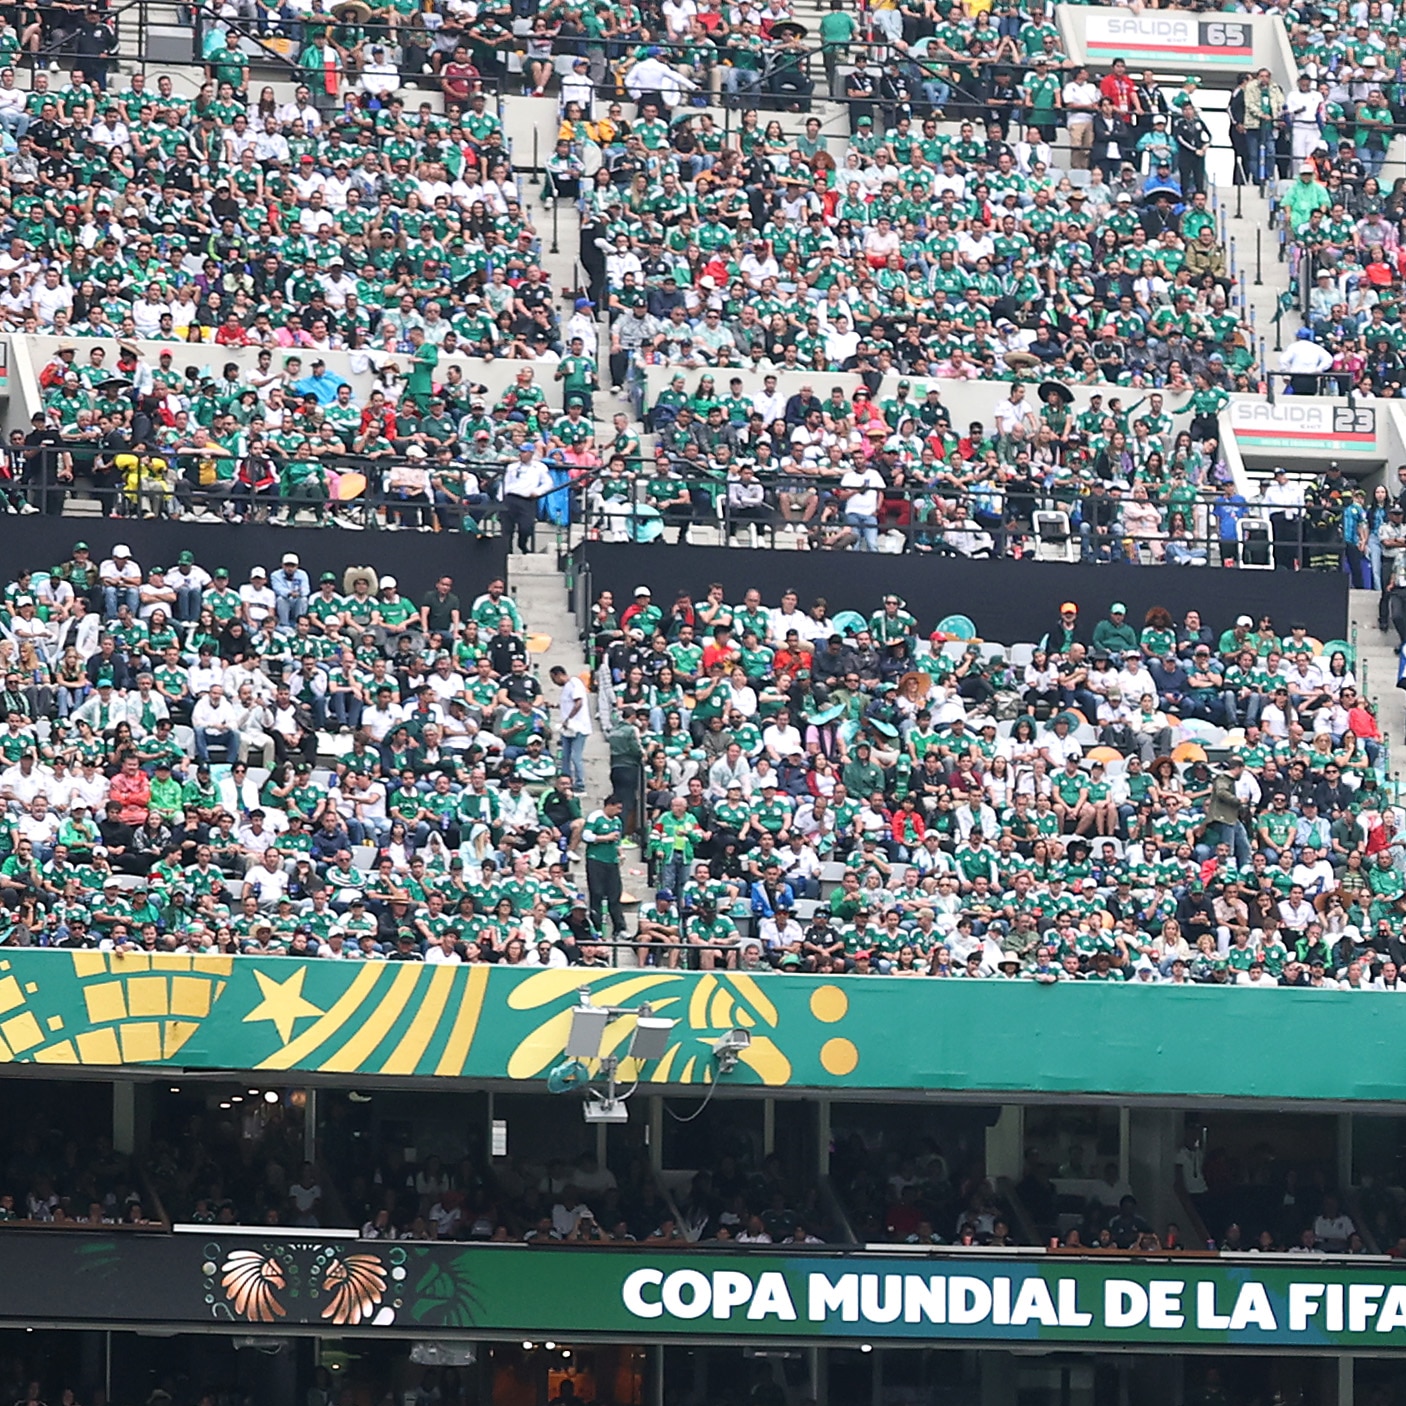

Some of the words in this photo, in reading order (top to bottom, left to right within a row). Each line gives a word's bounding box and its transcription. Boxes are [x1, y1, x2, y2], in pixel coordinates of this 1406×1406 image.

[1107, 18, 1188, 36] SALIDA
[1206, 23, 1245, 46] 65
[1238, 404, 1322, 423] SALIDA
[1334, 408, 1375, 433] 23
[622, 1268, 797, 1320] COPA
[808, 1273, 1093, 1326] MUNDIAL
[1104, 1279, 1185, 1328] DE
[1197, 1281, 1277, 1330] LA
